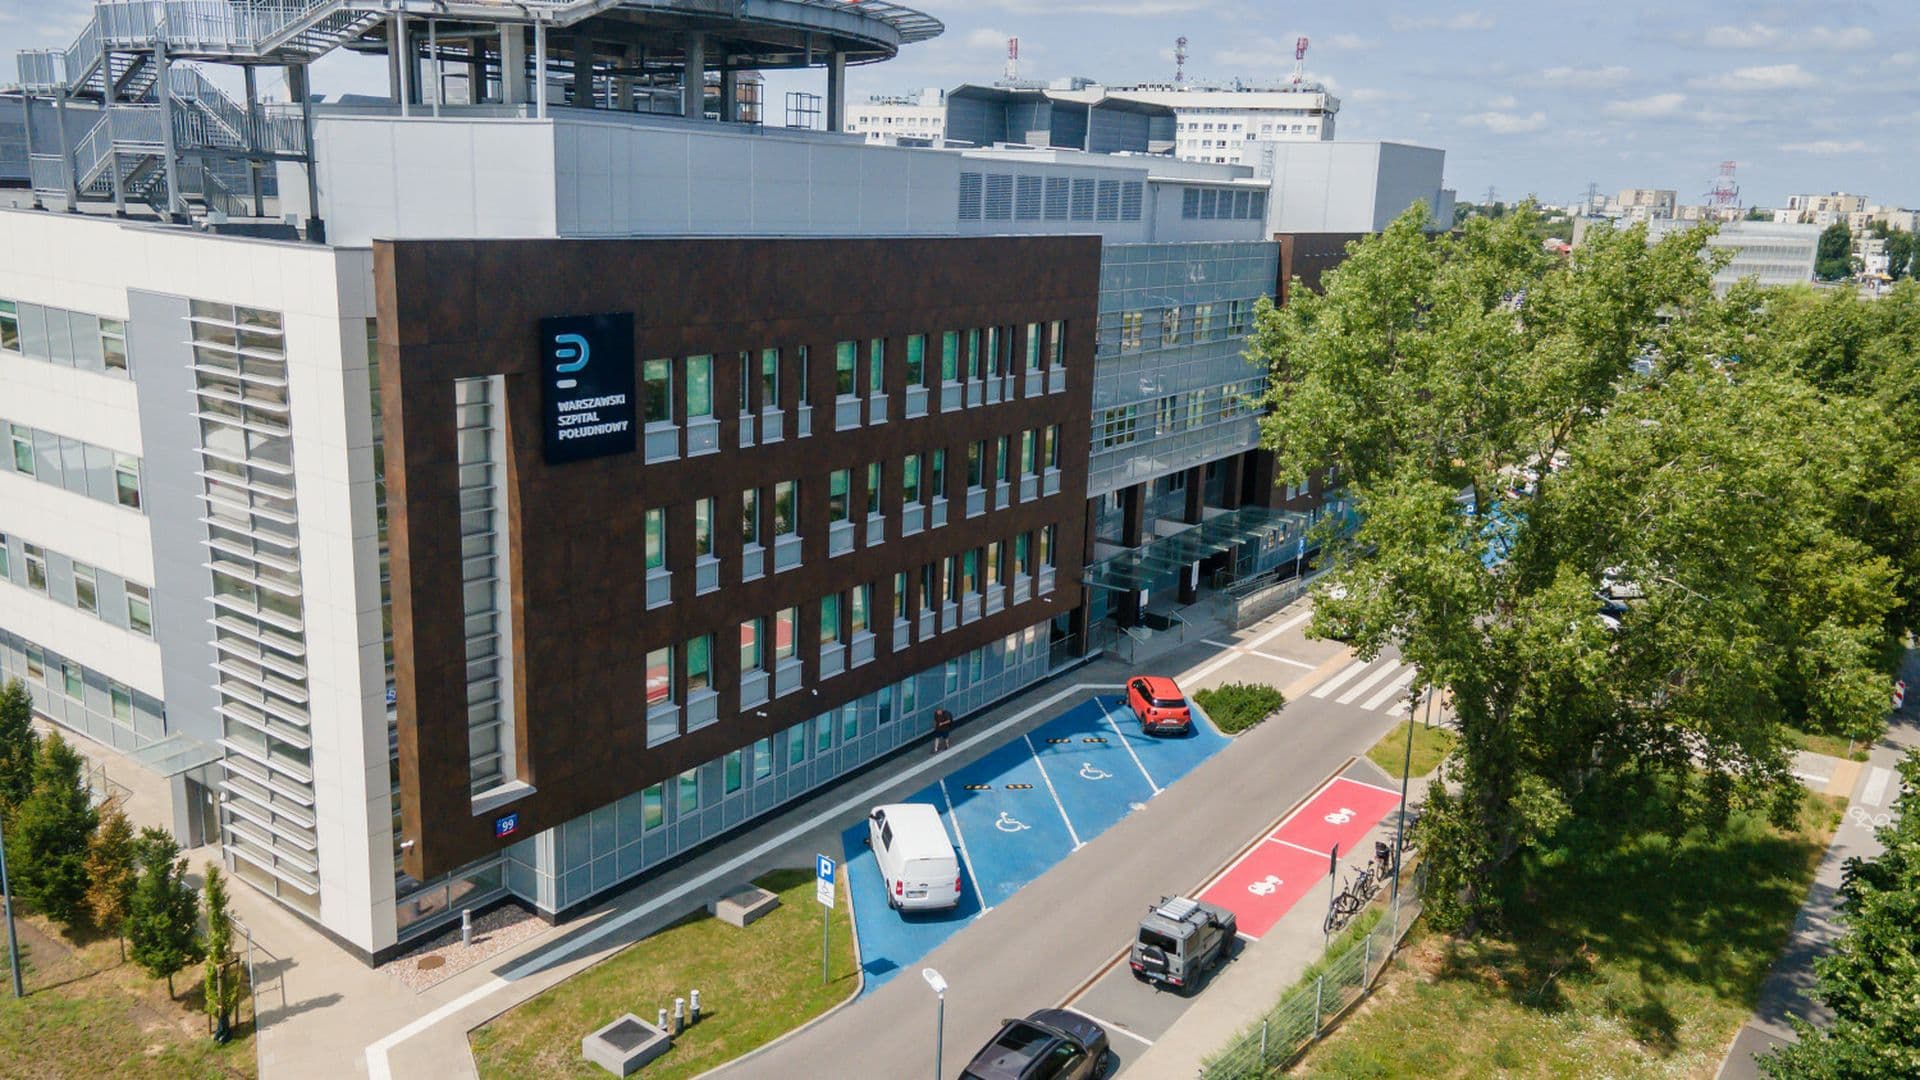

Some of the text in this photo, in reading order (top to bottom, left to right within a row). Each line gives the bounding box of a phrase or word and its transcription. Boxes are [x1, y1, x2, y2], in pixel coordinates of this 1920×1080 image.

[558, 394, 625, 411] WARSZAWSKI
[558, 412, 600, 426] SZPITAL
[559, 420, 628, 440] POŁUDNIOWY
[502, 819, 514, 832] 99
[821, 858, 832, 877] P
